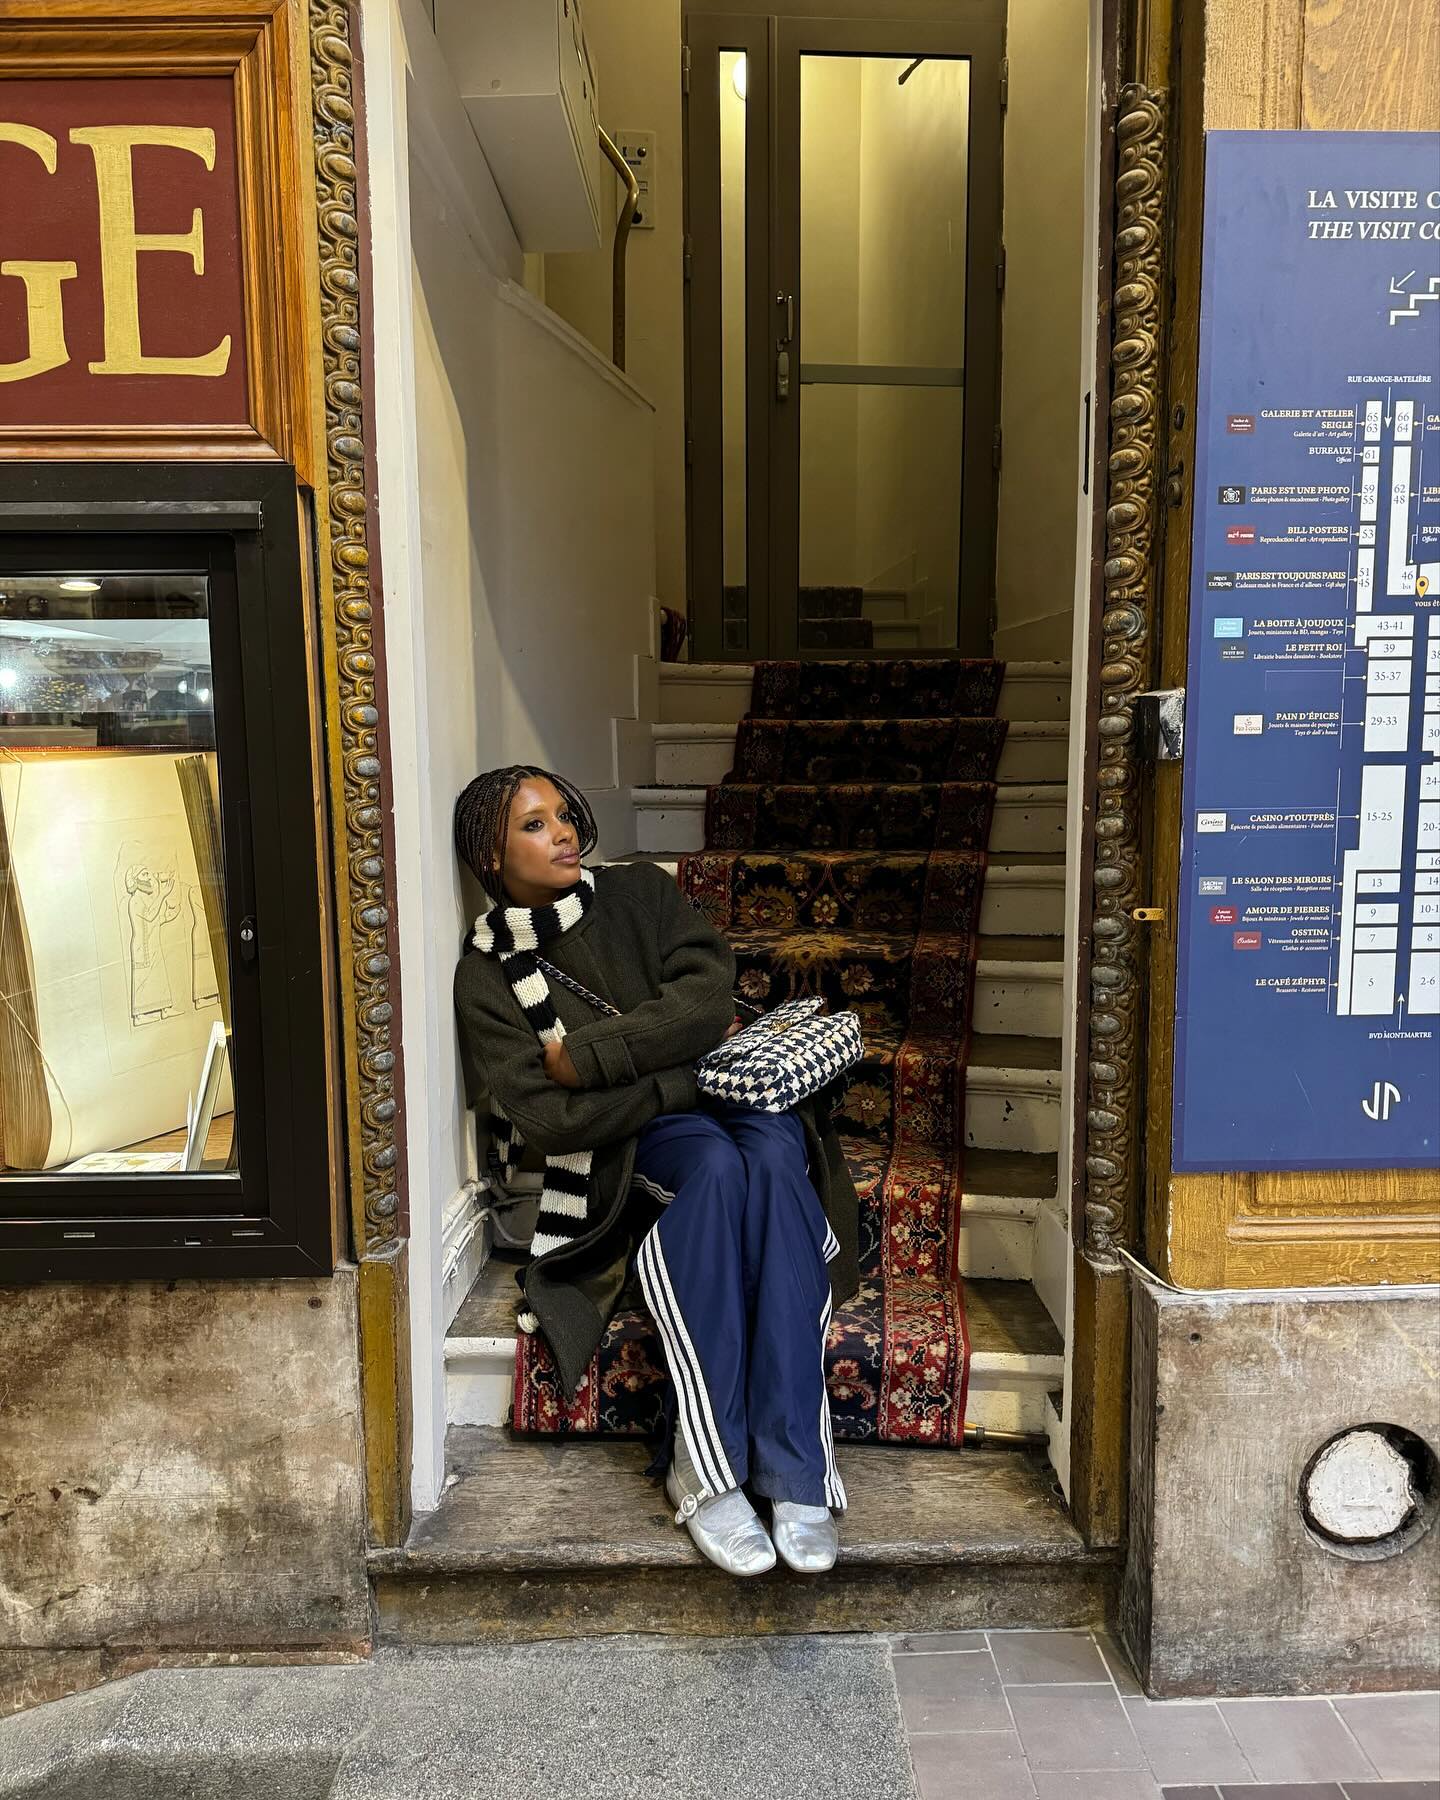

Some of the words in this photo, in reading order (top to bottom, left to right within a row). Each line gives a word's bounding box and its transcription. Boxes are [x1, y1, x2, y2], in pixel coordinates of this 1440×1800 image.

[1308, 191, 1337, 208] LA
[1344, 191, 1418, 208] VISITE
[1308, 222, 1352, 239] THE
[1358, 222, 1415, 239] VISIT
[1363, 374, 1431, 382] GRANGE-BATELIÈRE
[1367, 412, 1377, 421] 65
[1398, 412, 1409, 421] 66
[1321, 421, 1353, 429] SEIGLE
[1367, 424, 1377, 432] 63
[1397, 424, 1408, 432] 64
[1365, 450, 1375, 459] 61
[1363, 485, 1375, 493] 59
[1394, 485, 1405, 493] 62
[1363, 496, 1374, 504] 55
[1394, 496, 1405, 504] 48
[1362, 530, 1374, 538] 53
[1359, 568, 1369, 576] 51
[1402, 572, 1413, 580] 46
[1236, 572, 1260, 580] PARIS
[1260, 572, 1274, 580] EST
[1275, 572, 1321, 581] TOUJOURS
[1359, 579, 1369, 587] 45
[1296, 618, 1303, 627] À
[1303, 620, 1344, 628] JOUJOUX
[1377, 621, 1403, 630] 43-41
[1286, 644, 1297, 652] LE
[1299, 644, 1325, 652] PETIT
[1326, 644, 1342, 652] ROI
[1384, 644, 1395, 652] 39
[1374, 672, 1401, 680] 35-37
[1299, 711, 1339, 720] D'ÉPICES
[1371, 717, 1398, 726] 29-33
[1428, 729, 1440, 737] 30
[1250, 814, 1282, 822] CASINO
[1367, 812, 1392, 821] 15-25
[1430, 857, 1440, 865] 16
[1372, 879, 1382, 887] 13
[1429, 877, 1438, 885] 14
[1370, 909, 1376, 917] 9
[1420, 905, 1439, 913] 10-1
[1370, 934, 1375, 942] 7
[1427, 933, 1432, 941] 8
[1268, 977, 1290, 985] CAFÉ
[1291, 977, 1326, 985] ZÉPHYR
[1368, 978, 1374, 986] 5
[1420, 977, 1436, 985] 2-6
